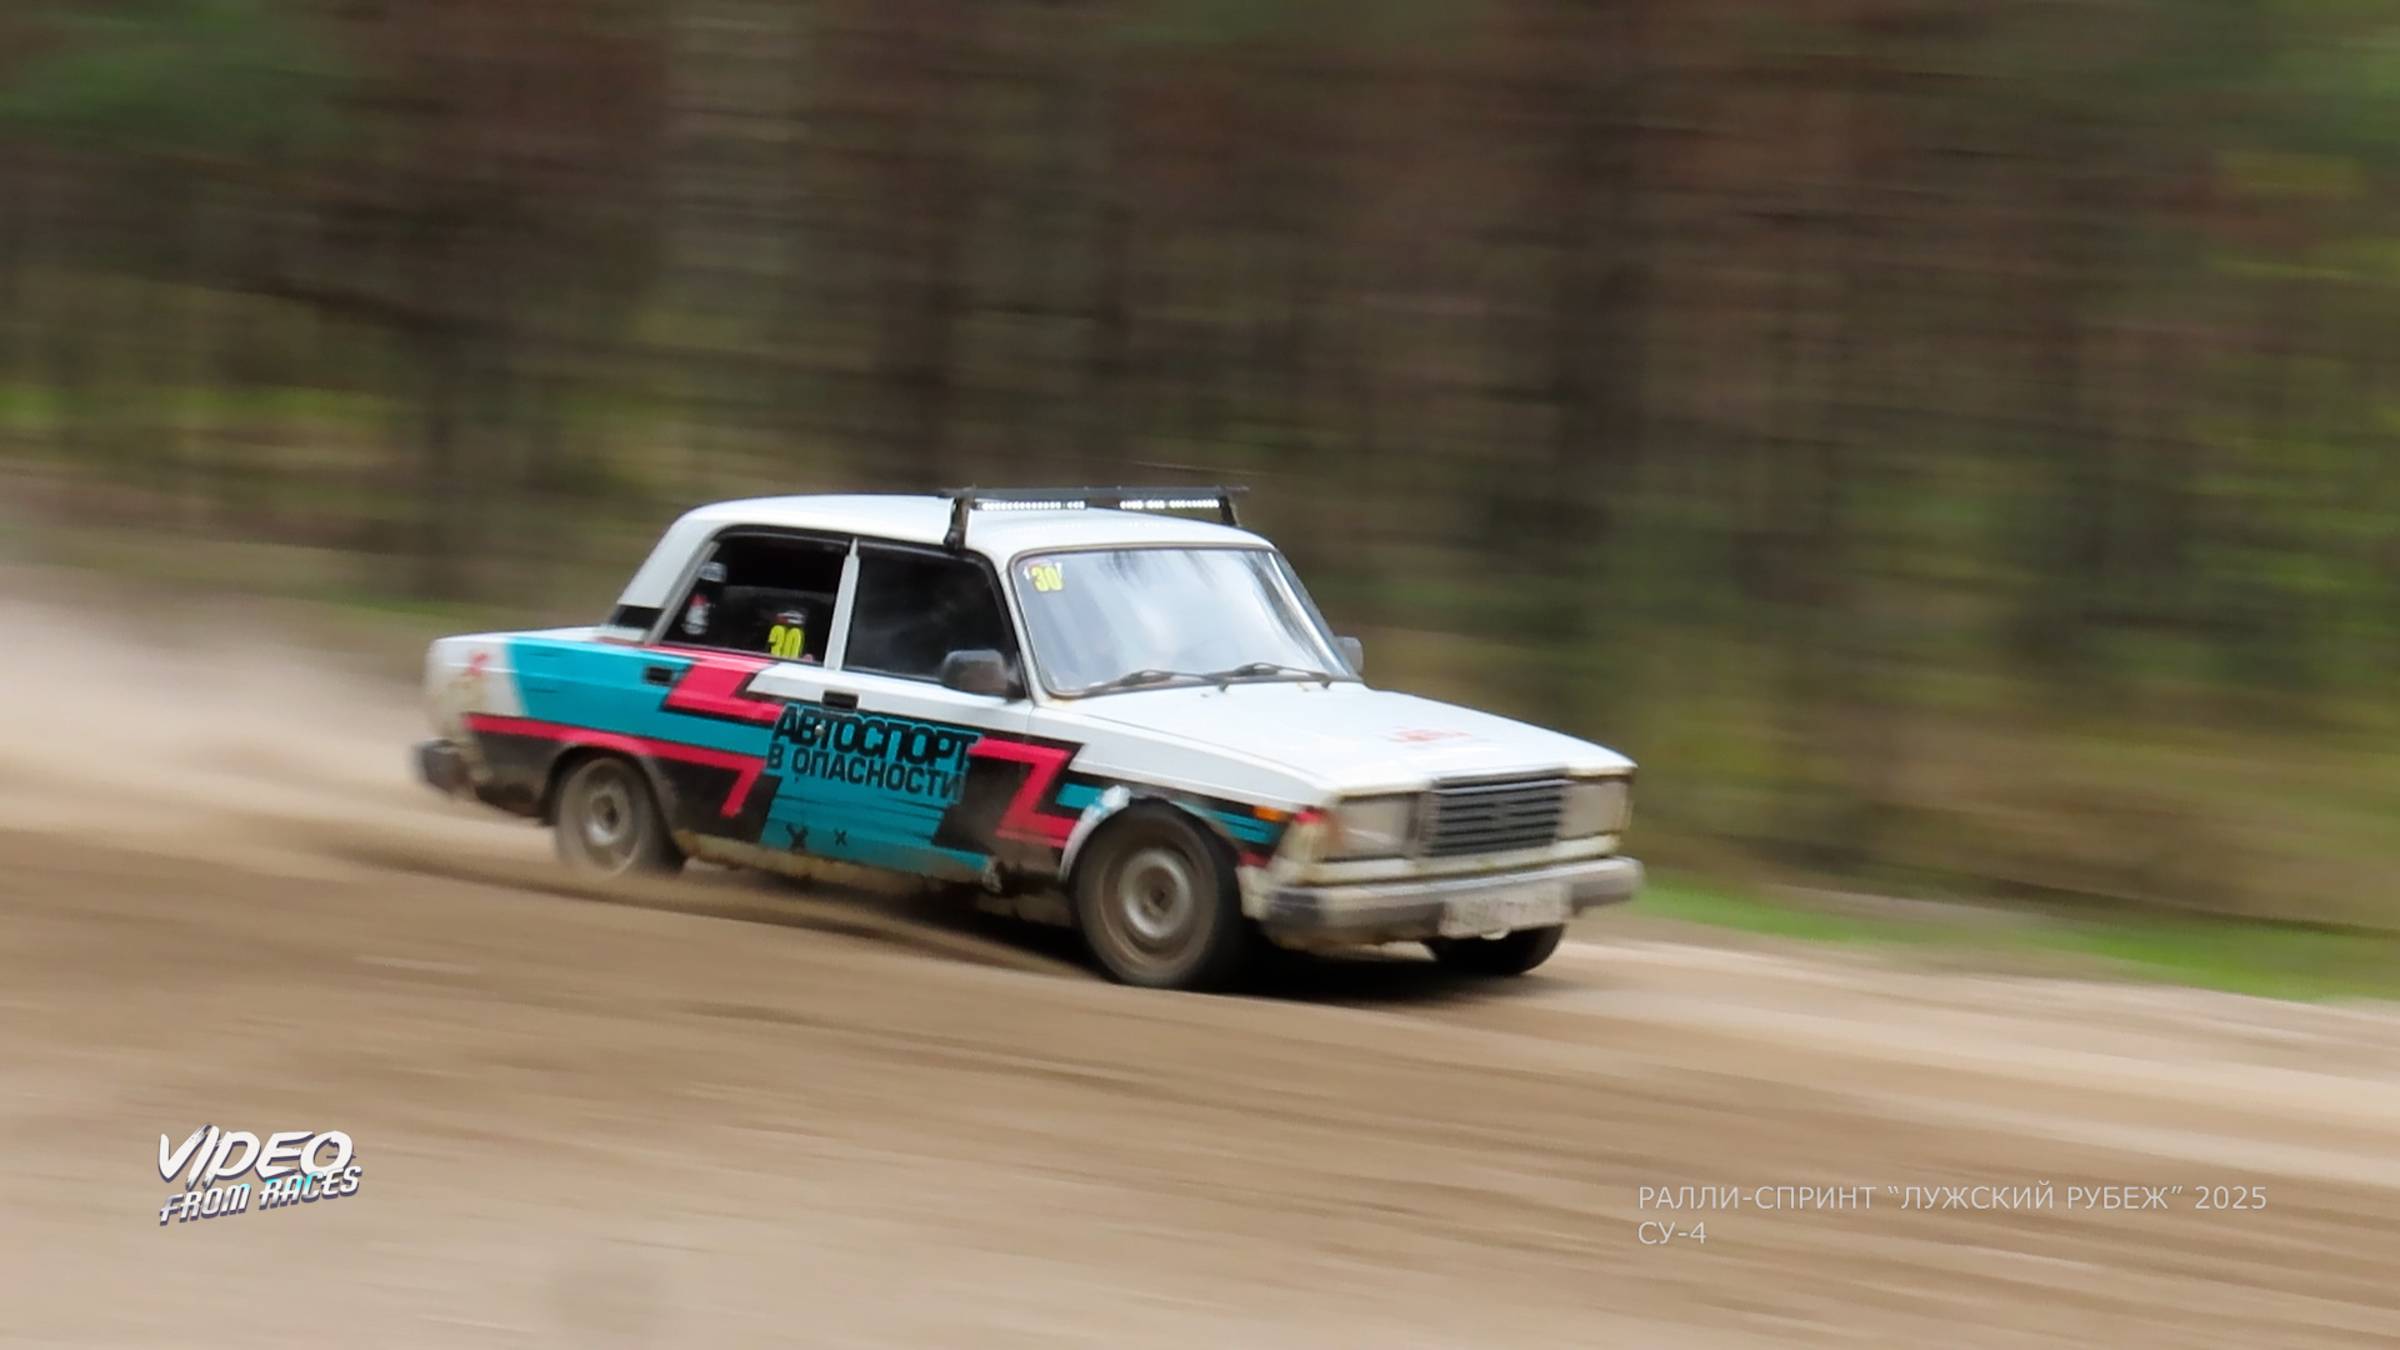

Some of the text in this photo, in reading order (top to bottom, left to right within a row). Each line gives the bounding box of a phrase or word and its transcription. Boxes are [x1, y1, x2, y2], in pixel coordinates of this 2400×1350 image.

[1031, 565, 1063, 591] 30
[768, 624, 804, 658] 30
[772, 703, 981, 772] АВТОСПОРТ
[767, 743, 963, 799] В ОПАСНОСТИ
